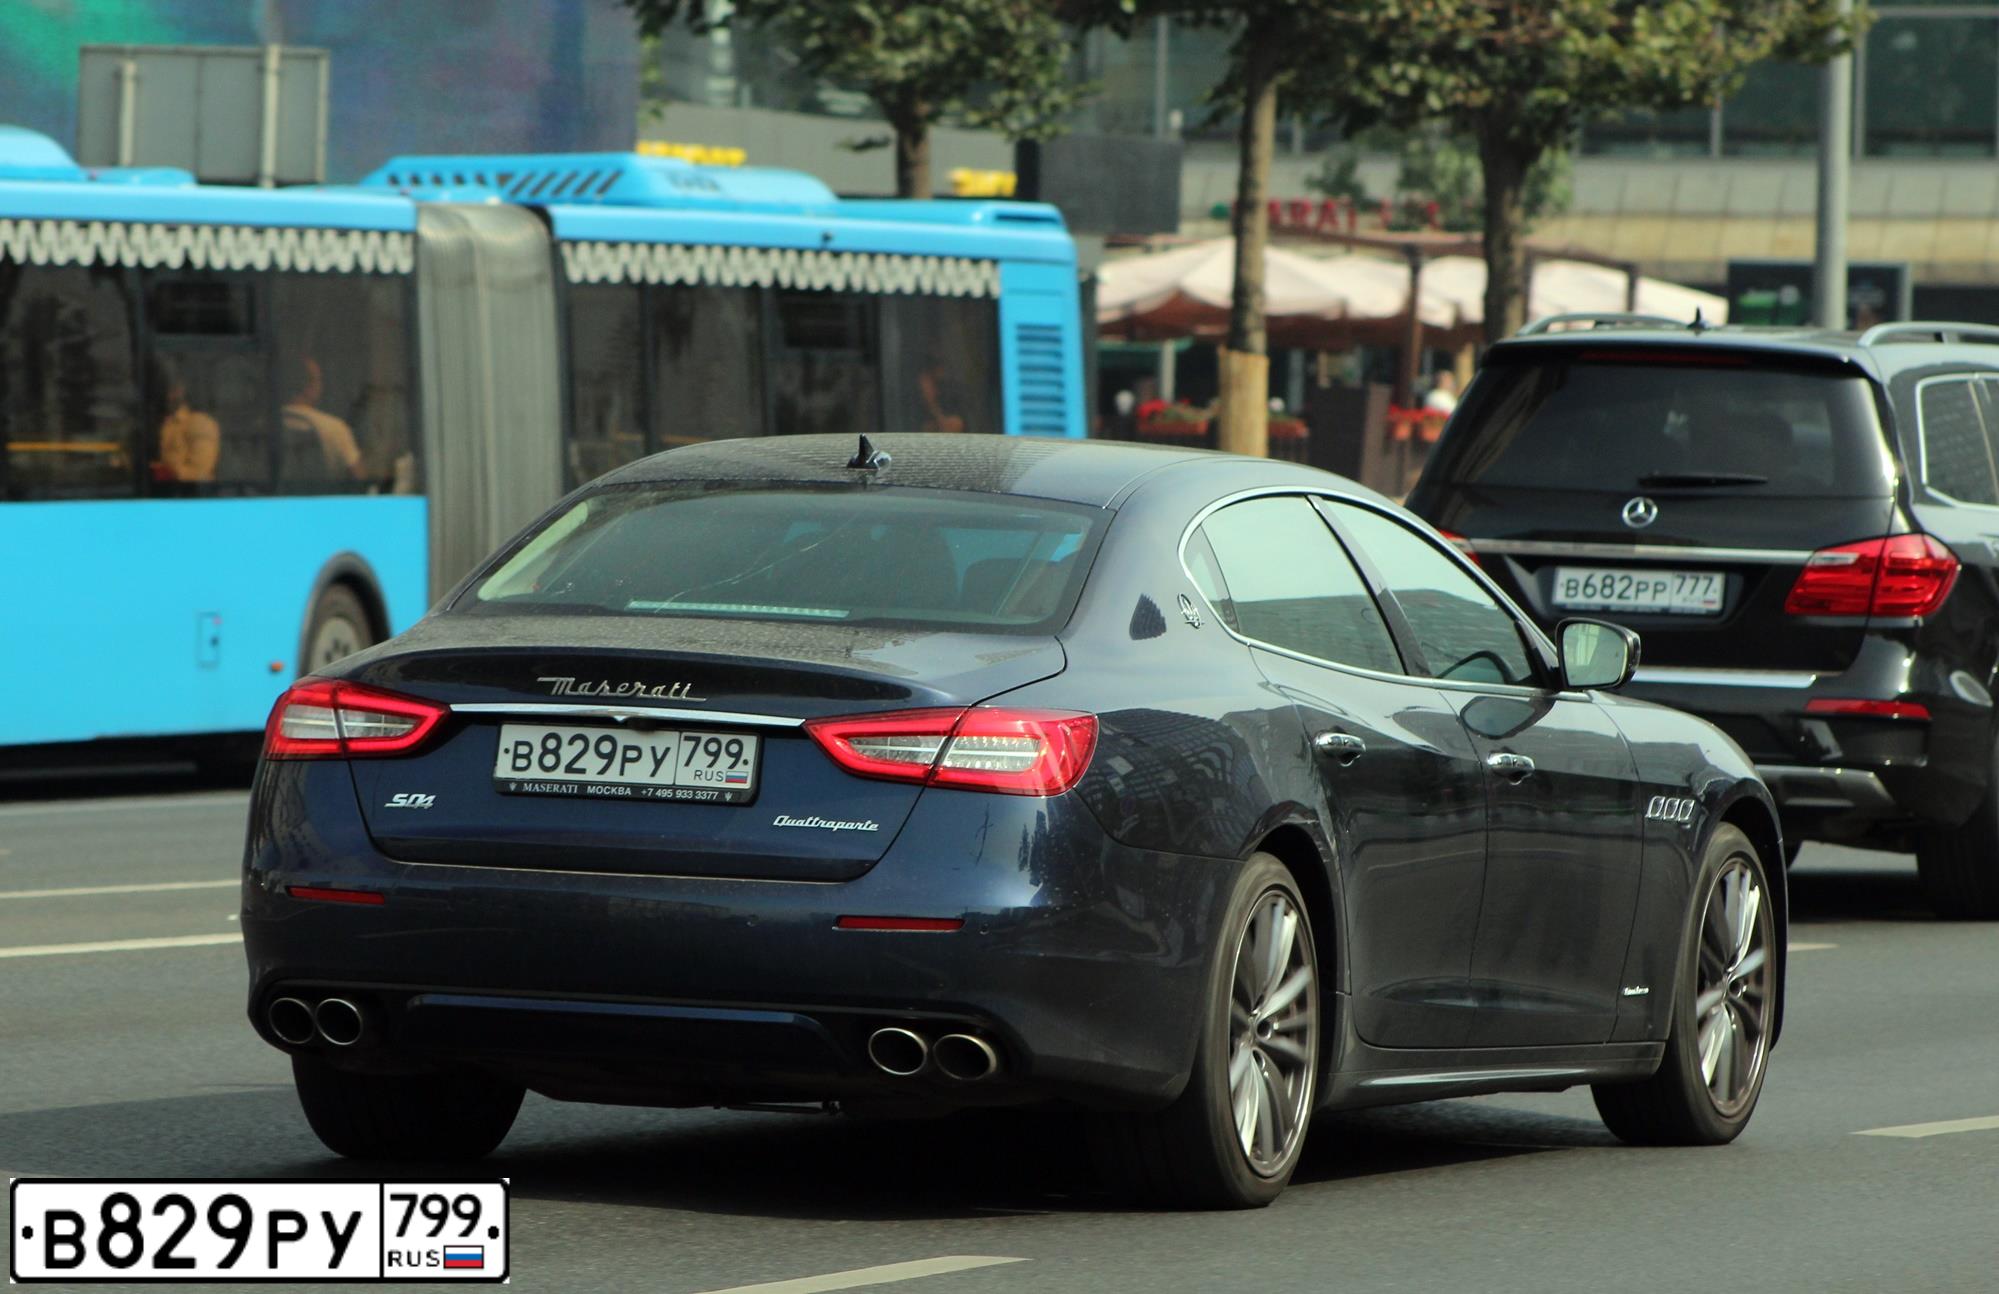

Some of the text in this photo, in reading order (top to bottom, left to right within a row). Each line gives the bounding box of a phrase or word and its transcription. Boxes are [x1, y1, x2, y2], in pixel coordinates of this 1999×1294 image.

[1565, 573, 1714, 600] В682РР 777
[537, 677, 707, 702] Maserati
[511, 732, 744, 777] В829РУ 799
[694, 769, 724, 781] RUS
[522, 782, 578, 794] MASERATI
[586, 785, 719, 800] МОСКВА +7 495 933 3377
